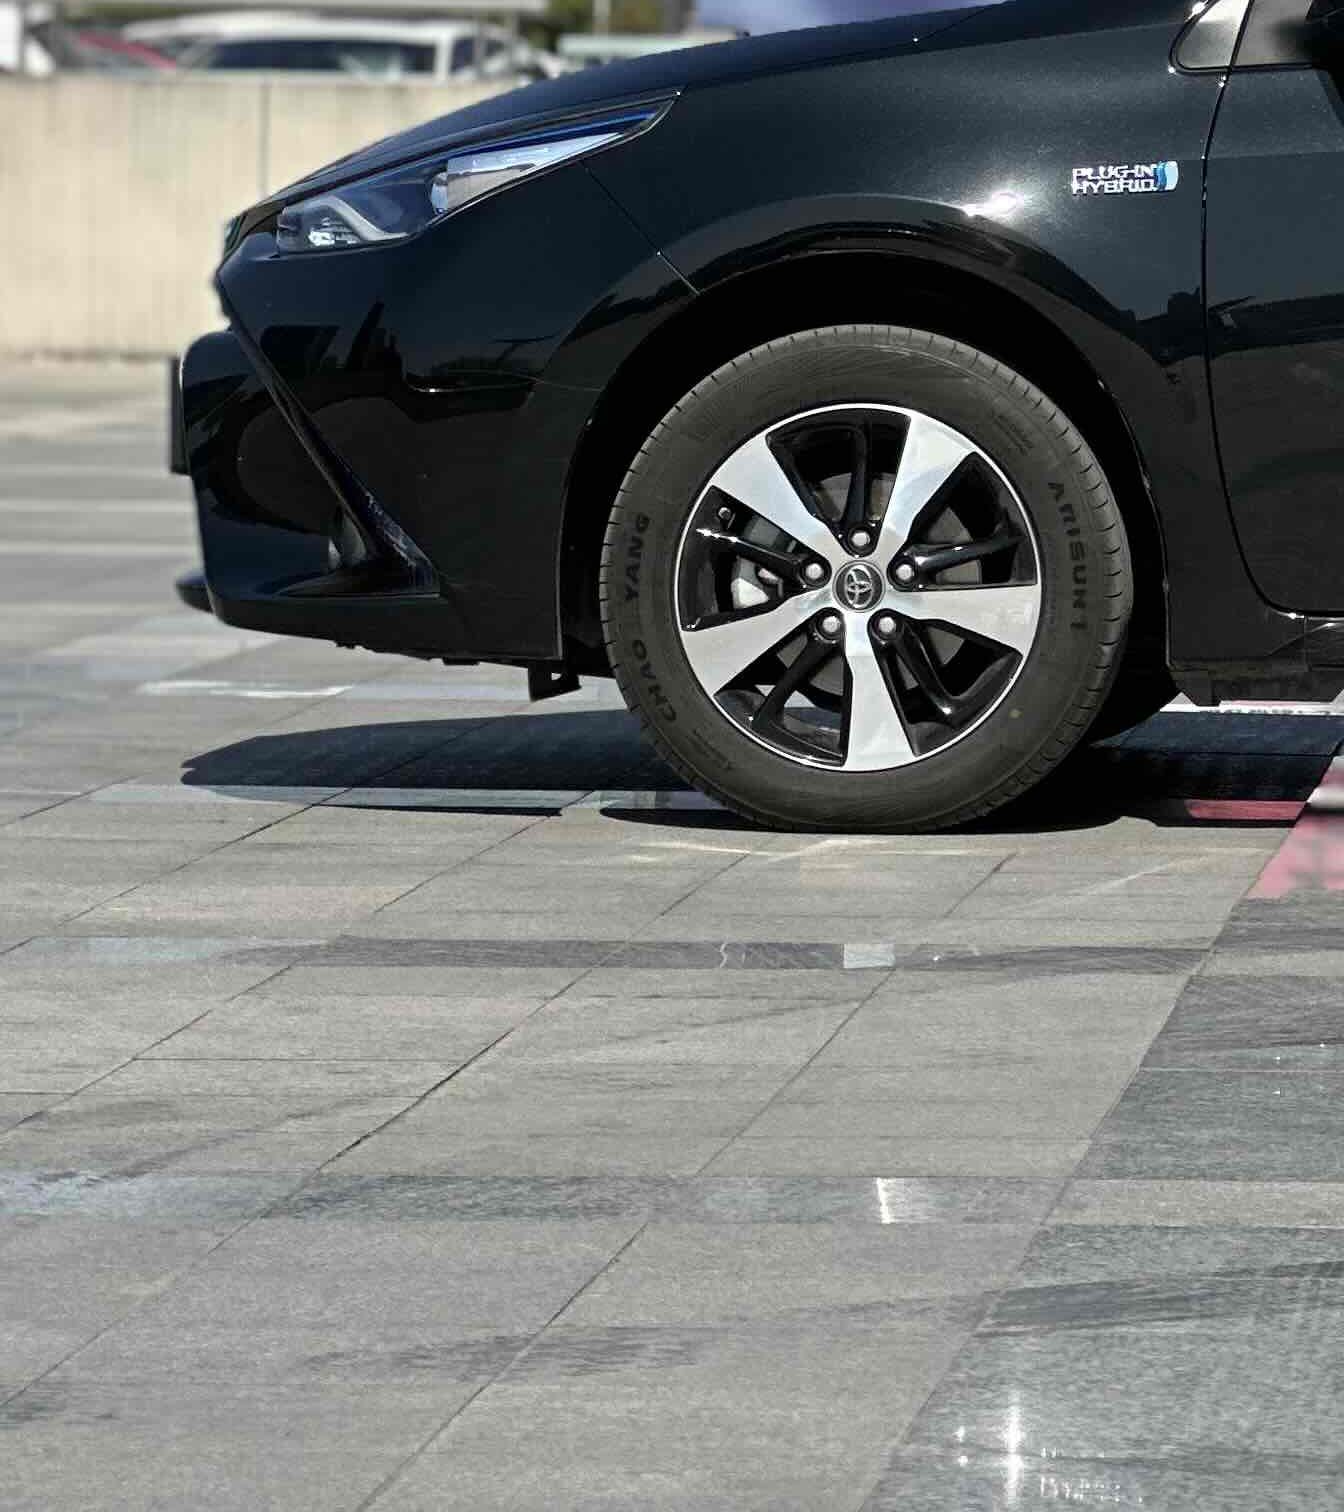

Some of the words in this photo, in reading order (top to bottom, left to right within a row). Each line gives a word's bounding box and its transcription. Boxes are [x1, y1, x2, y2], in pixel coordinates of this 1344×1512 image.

[1071, 178, 1157, 194] HYBRID
[1072, 164, 1154, 180] PLUG-IN
[625, 513, 651, 601] YANG
[1048, 482, 1088, 609] ARISUN
[632, 639, 677, 722] CHAO
